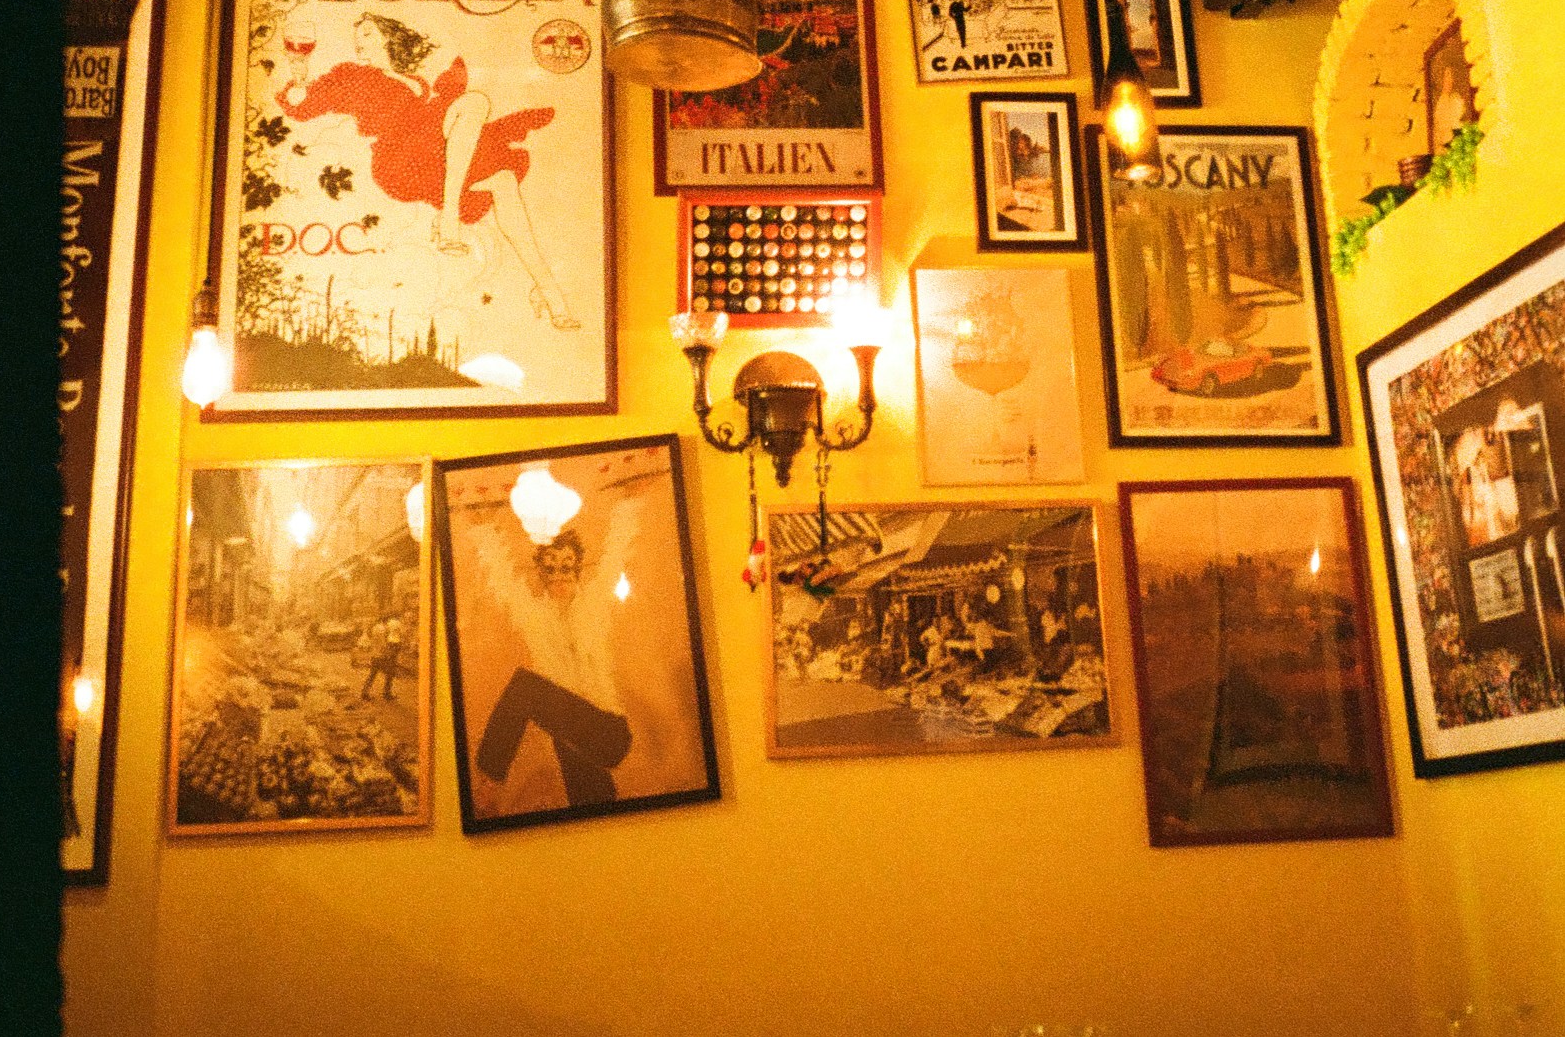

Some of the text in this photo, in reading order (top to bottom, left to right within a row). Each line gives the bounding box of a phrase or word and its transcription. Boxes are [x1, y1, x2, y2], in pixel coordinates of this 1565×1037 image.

[1006, 41, 1054, 52] BITTER
[931, 50, 1054, 73] CAMPARI
[701, 142, 838, 175] ITALIEN
